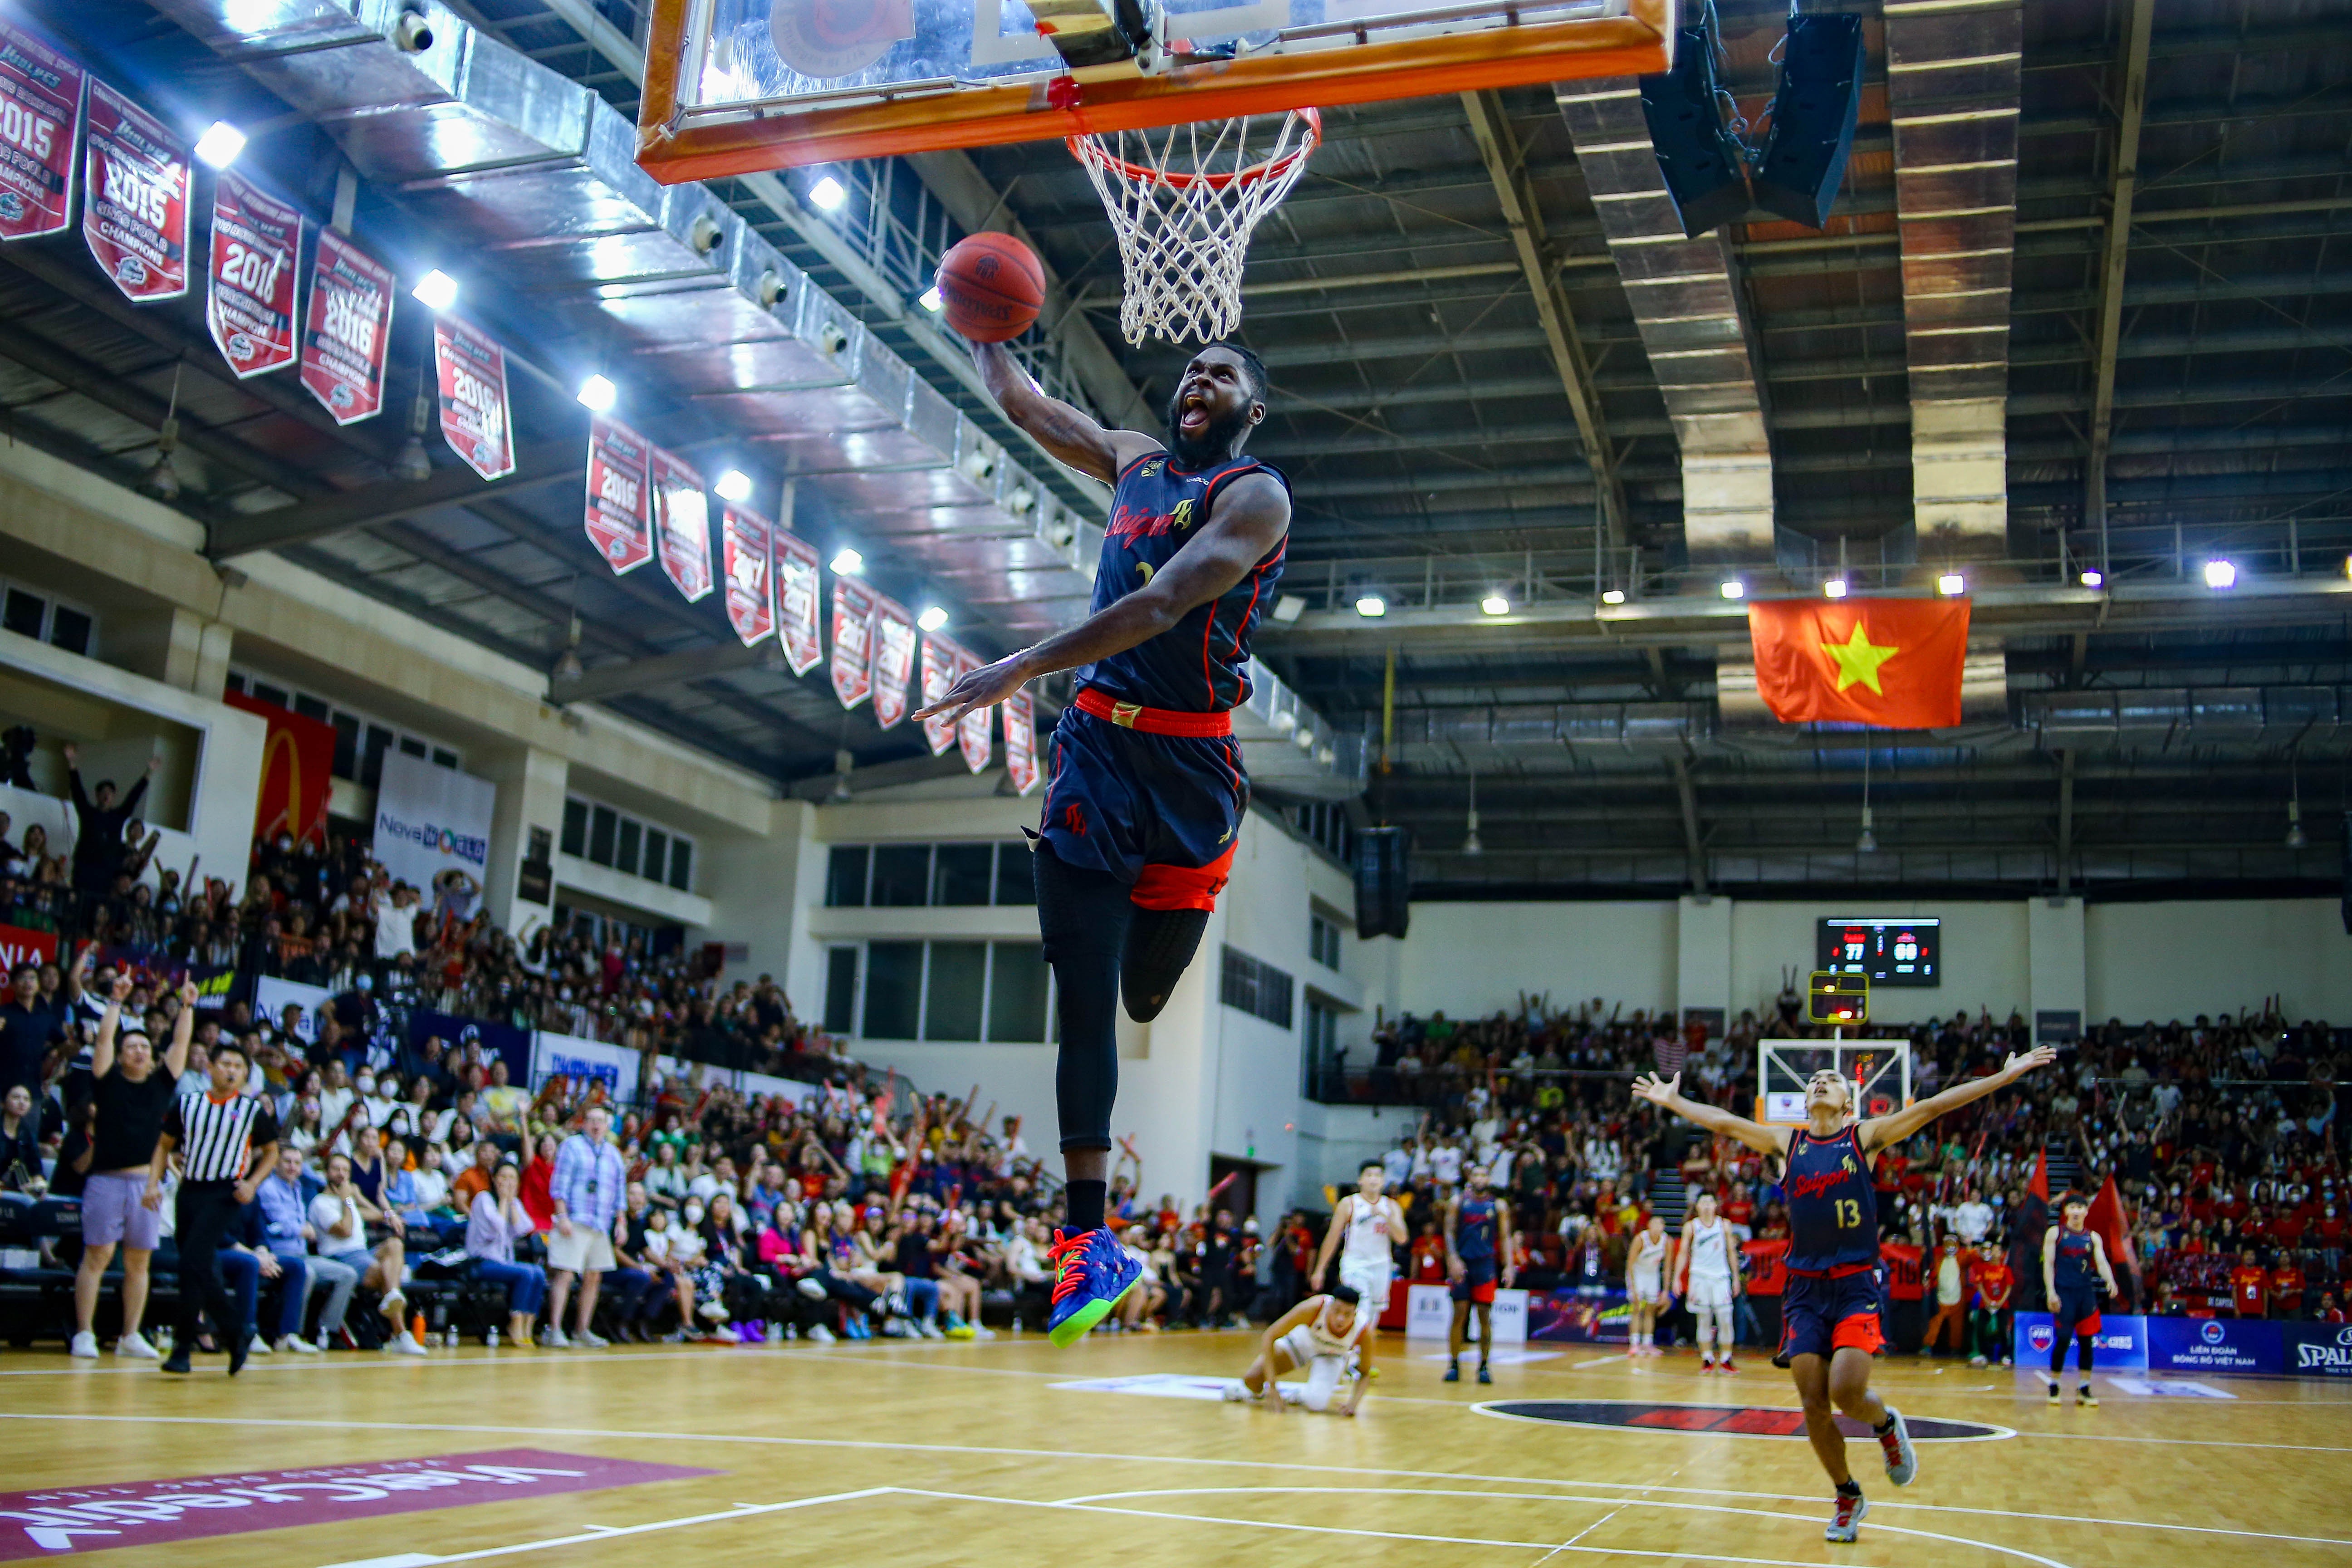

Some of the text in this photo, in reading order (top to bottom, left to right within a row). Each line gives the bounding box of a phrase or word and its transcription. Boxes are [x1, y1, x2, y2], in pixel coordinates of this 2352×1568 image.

[0, 95, 54, 159] 015
[100, 221, 164, 267] CHAMPIONS
[1793, 1170, 1849, 1199] Saigon
[1834, 1198, 1861, 1229] 13
[2234, 1357, 2256, 1366] NAM
[2297, 1343, 2352, 1367] SPAL
[0, 1464, 587, 1526] VietCredit
